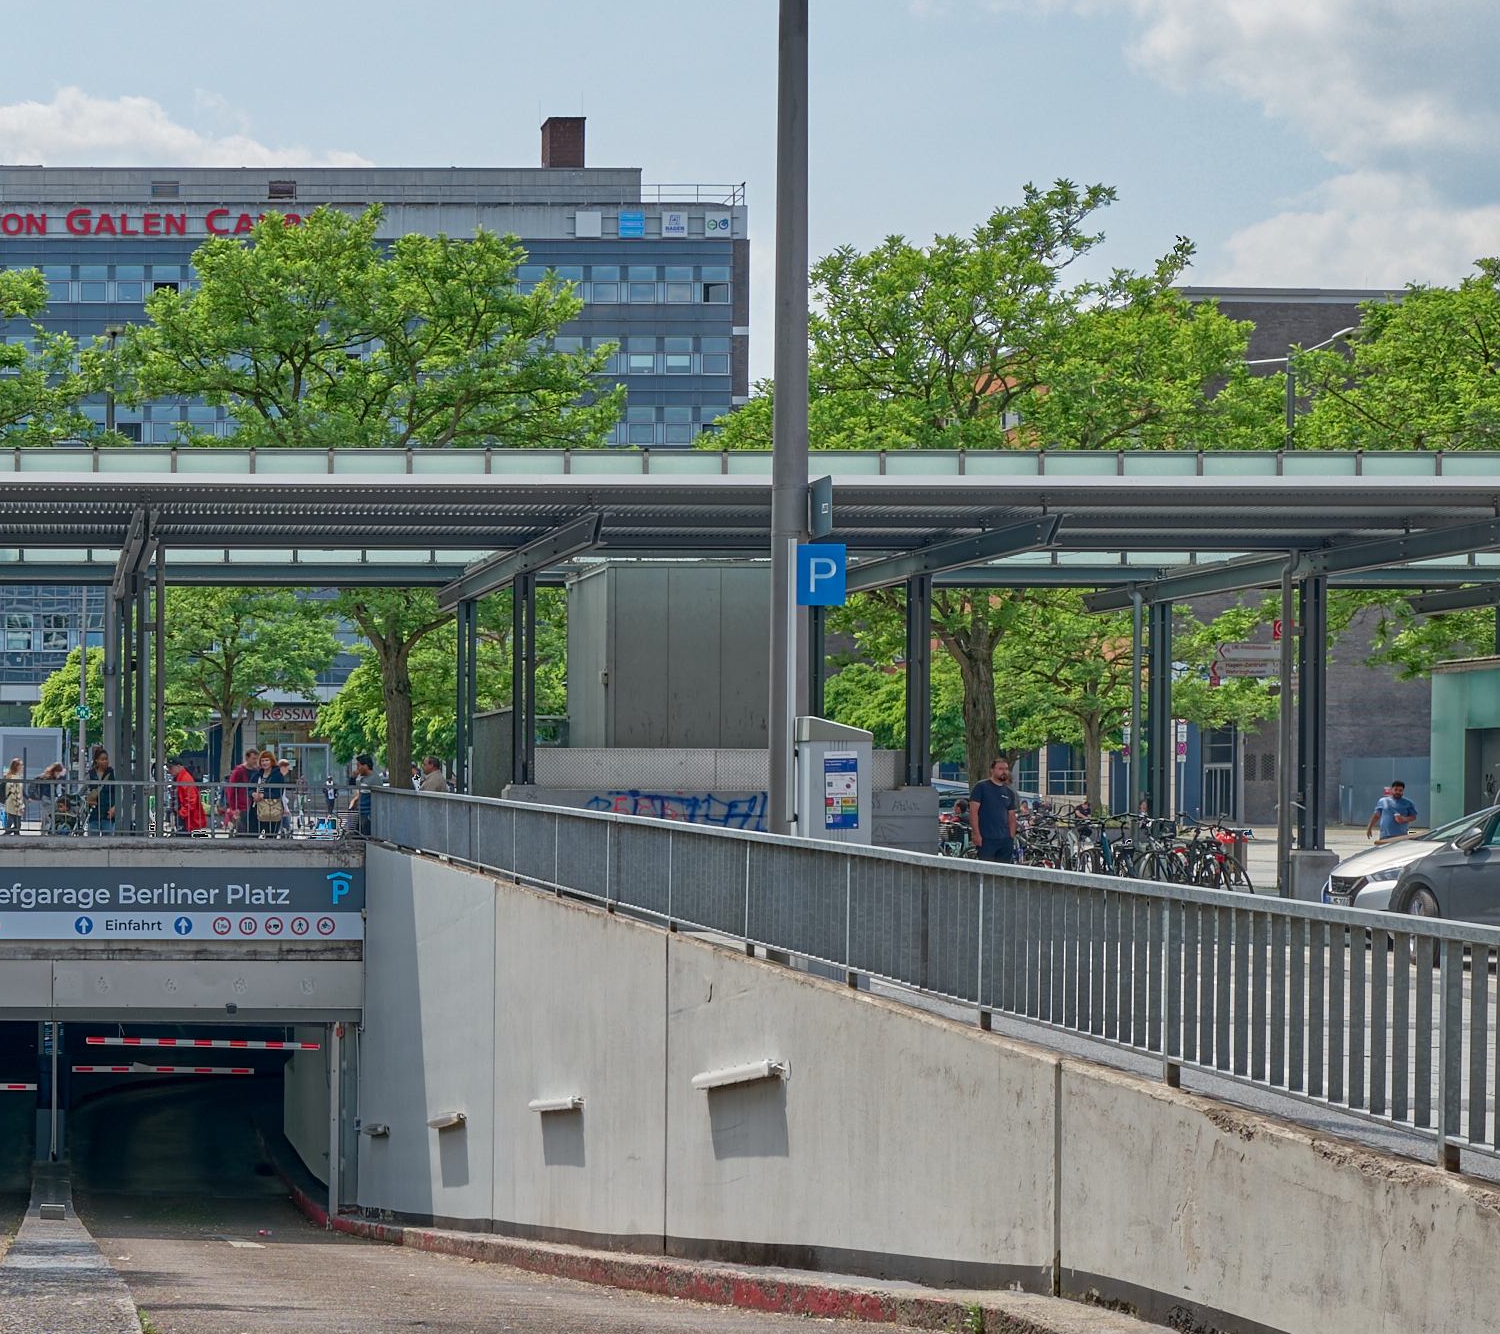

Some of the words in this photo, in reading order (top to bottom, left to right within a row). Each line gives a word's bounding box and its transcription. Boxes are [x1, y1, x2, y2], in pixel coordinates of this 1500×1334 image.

[66, 208, 187, 236] GALEN
[809, 557, 837, 593] P
[262, 707, 318, 720] ROSSM
[118, 882, 219, 905] Berliner
[227, 883, 290, 905] Platz
[105, 919, 163, 931] Einfahrt
[244, 921, 253, 931] 10
